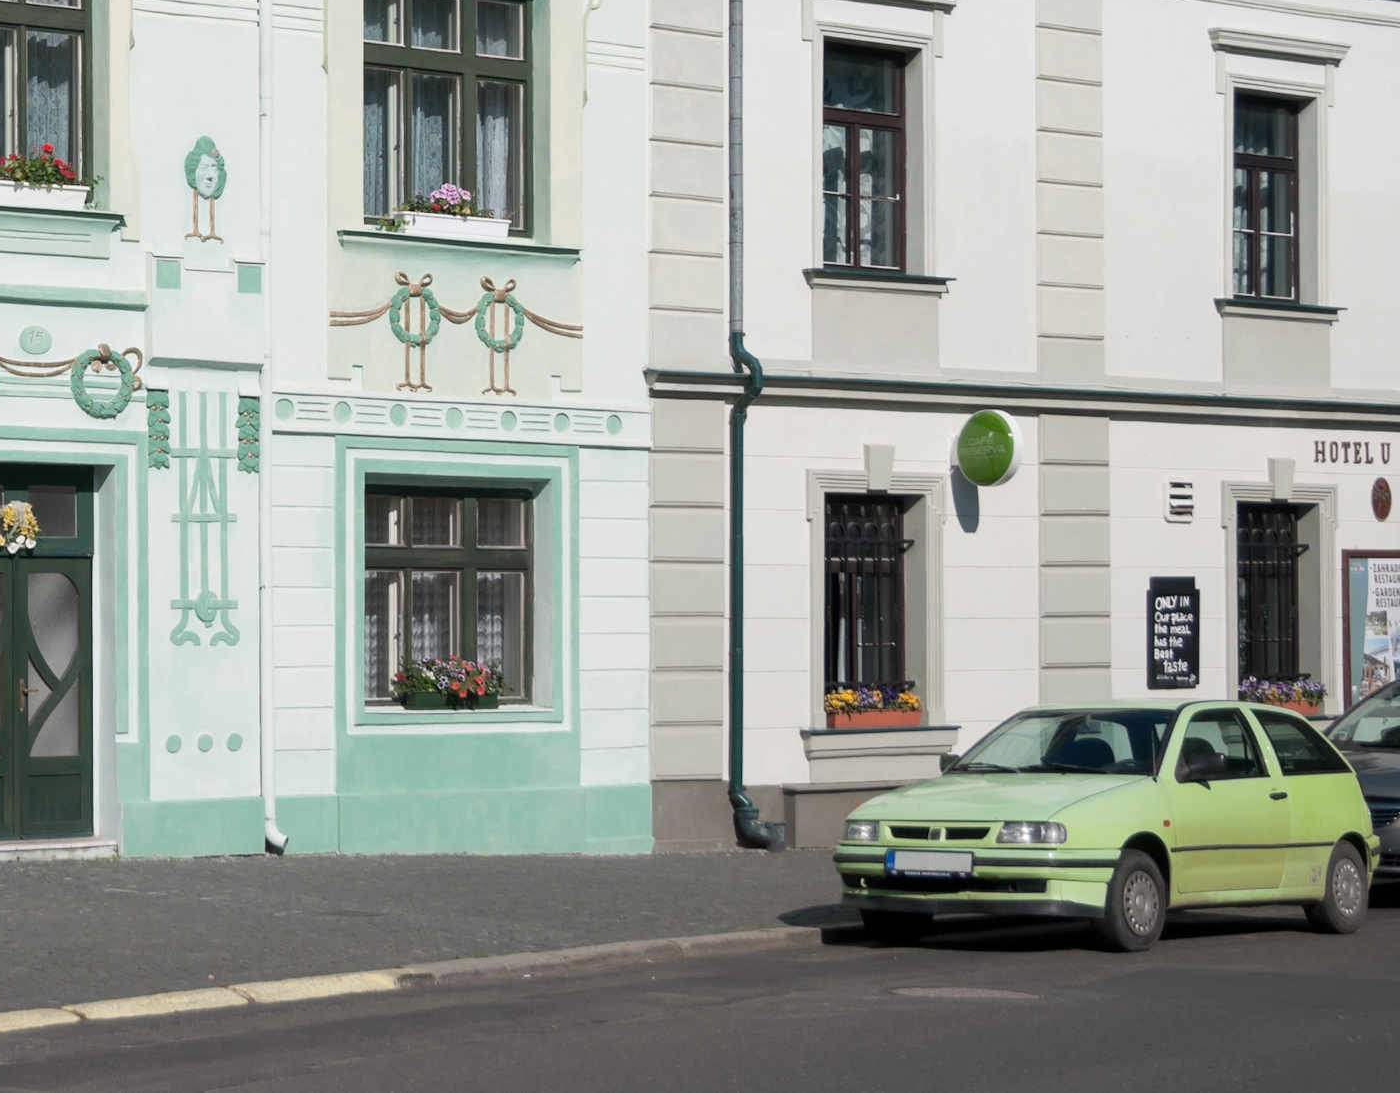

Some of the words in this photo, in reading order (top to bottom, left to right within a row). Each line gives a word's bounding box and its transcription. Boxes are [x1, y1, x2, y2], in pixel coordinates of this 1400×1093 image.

[28, 330, 44, 347] 15
[960, 445, 1006, 456] RESERVA
[1313, 440, 1374, 464] HOTEL
[1380, 442, 1391, 464] U
[1373, 563, 1400, 573] ZAHRAD
[1154, 595, 1177, 611] ONLY
[1179, 596, 1190, 608] IN
[1376, 598, 1400, 608] RESTAU
[1154, 611, 1170, 623] Our
[1154, 623, 1168, 634] the
[1154, 635, 1168, 647] has
[1169, 636, 1183, 648] the
[1163, 659, 1189, 673] taste
